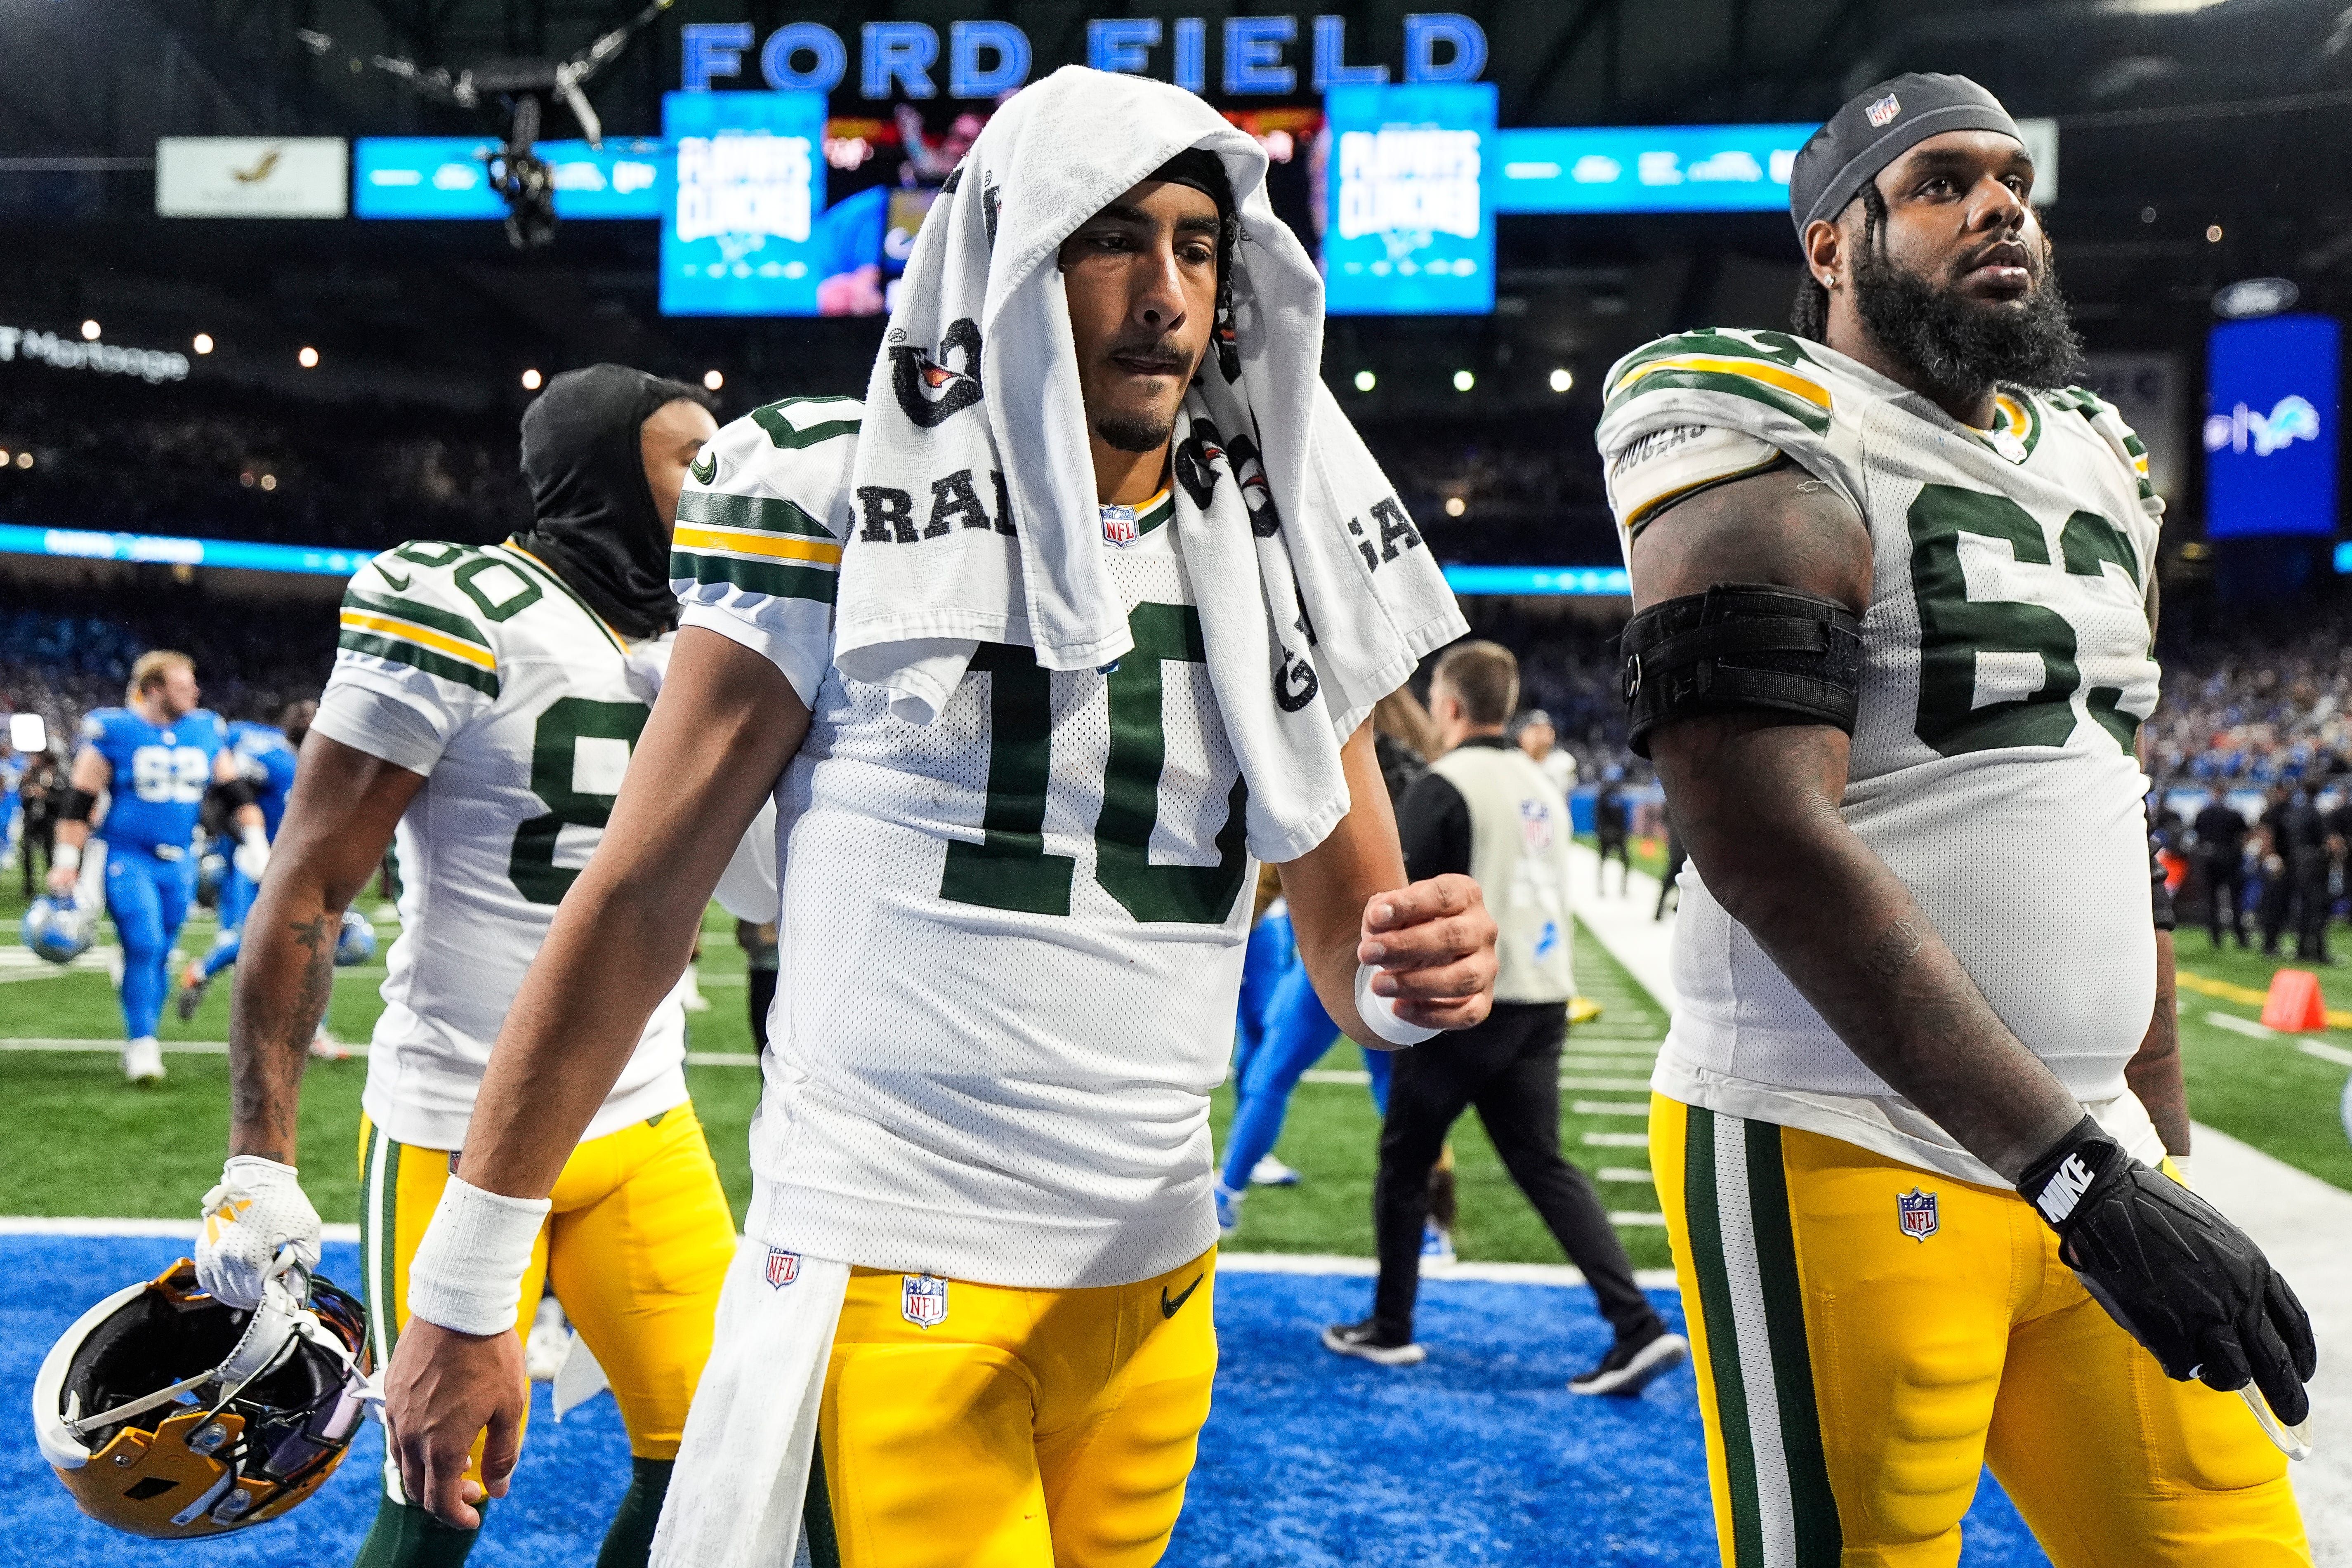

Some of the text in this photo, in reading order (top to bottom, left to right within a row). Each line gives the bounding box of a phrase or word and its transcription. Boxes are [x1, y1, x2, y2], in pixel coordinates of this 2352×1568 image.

[681, 13, 1489, 99] FORD FIELD
[1874, 104, 1898, 123] NFL
[1106, 521, 1134, 542] NFL
[939, 600, 1248, 923] 10
[2036, 1153, 2095, 1224] NIKE
[1905, 1211, 1934, 1231] NFL
[768, 1255, 795, 1283] NFL
[910, 1296, 940, 1318] NFL
